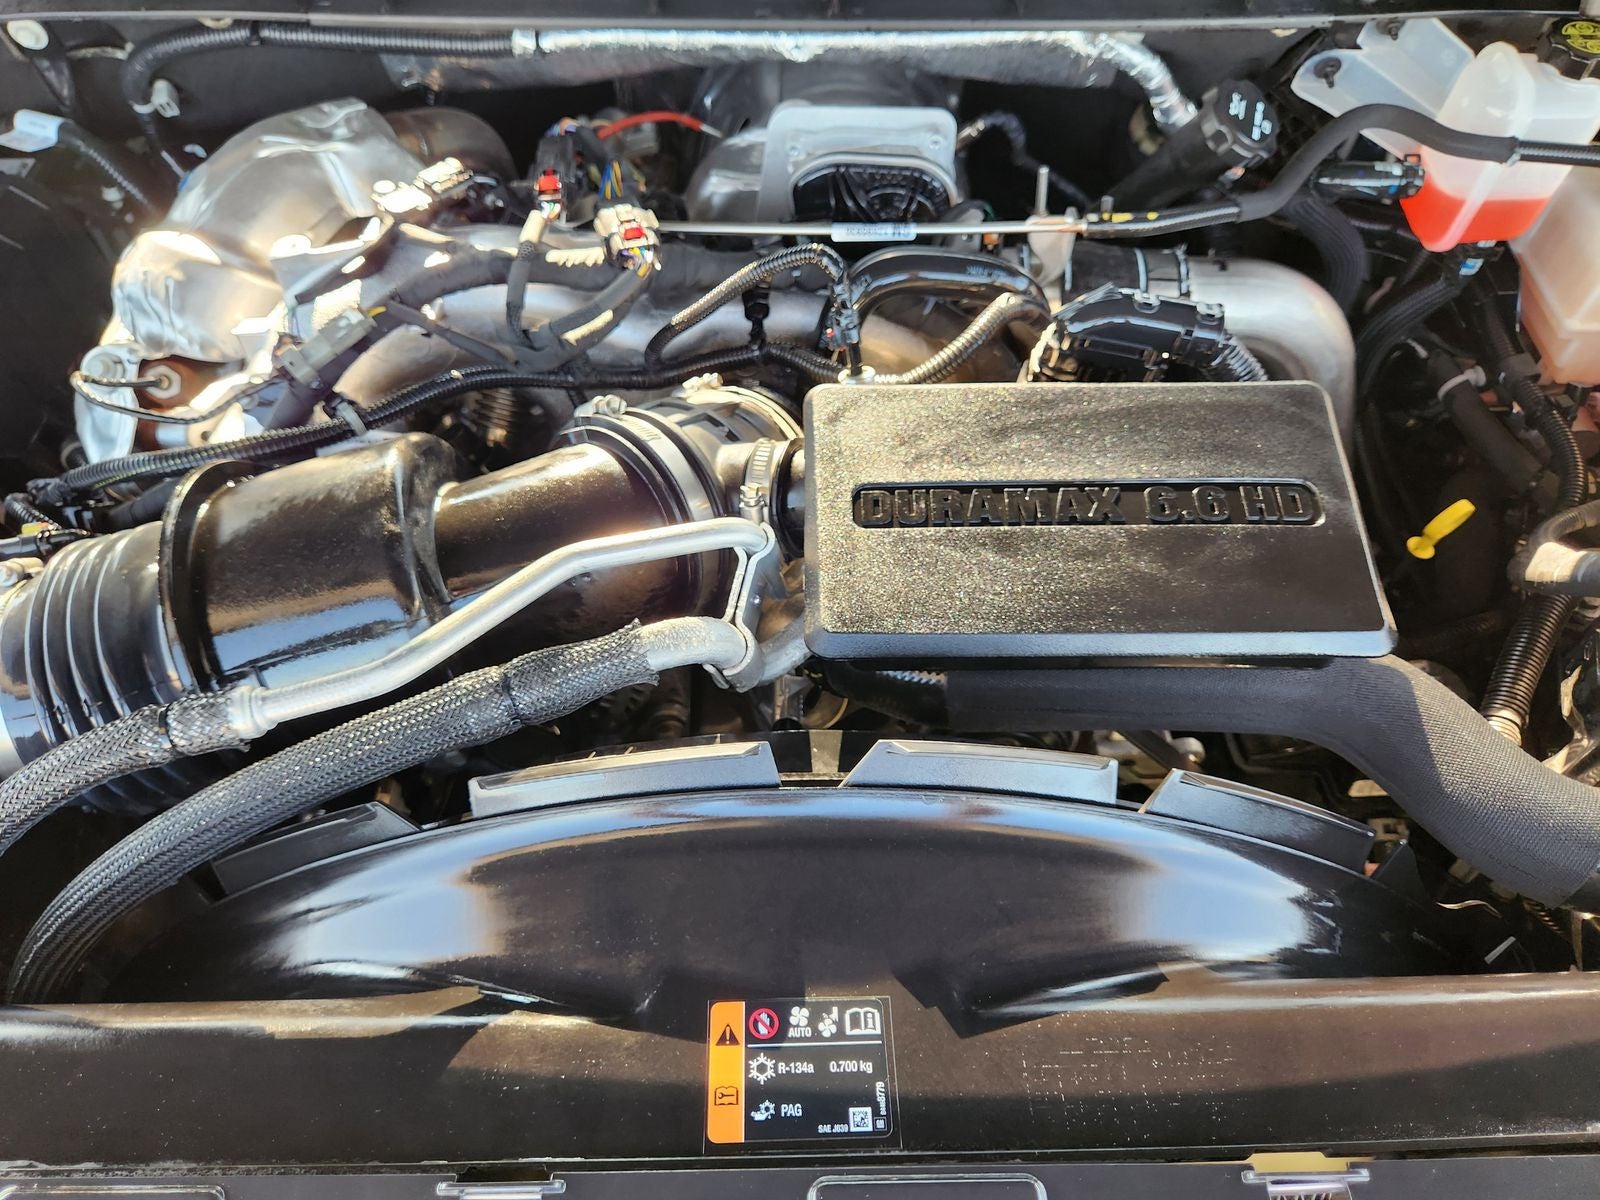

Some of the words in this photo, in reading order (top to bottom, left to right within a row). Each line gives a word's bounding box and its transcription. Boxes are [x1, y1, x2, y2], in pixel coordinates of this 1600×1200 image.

[859, 487, 1125, 524] DURAMAX
[1143, 486, 1230, 523] 6.6
[1239, 485, 1316, 522] HD
[788, 1027, 812, 1038] AUTO
[777, 1062, 814, 1074] R-134a
[829, 1060, 858, 1073] 0.700
[859, 1060, 873, 1073] kg
[781, 1104, 803, 1117] PAG
[817, 1124, 832, 1134] SAE
